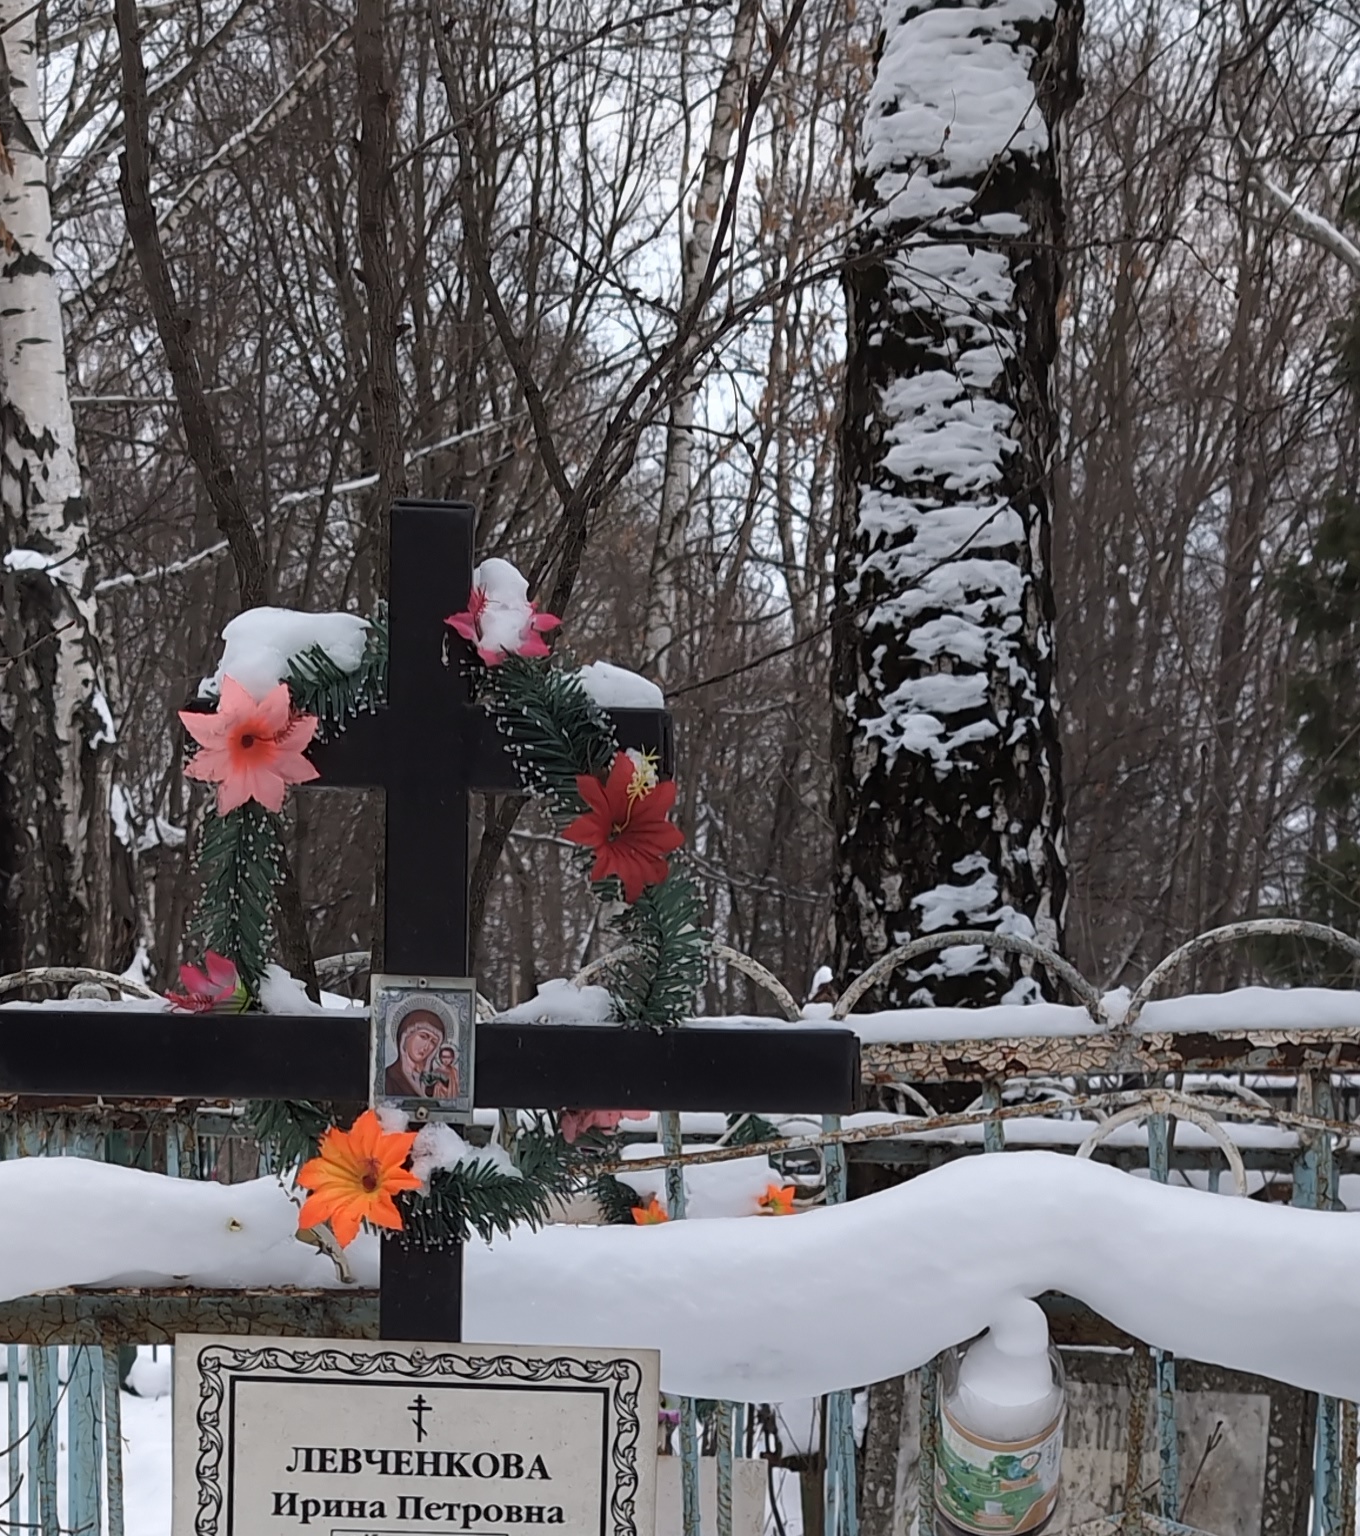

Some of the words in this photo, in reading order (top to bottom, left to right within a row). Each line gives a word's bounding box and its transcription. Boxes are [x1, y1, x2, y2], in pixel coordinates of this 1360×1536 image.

[285, 1446, 553, 1480] ЛЕВЧЕНКОВА
[271, 1491, 388, 1525] Ирина
[396, 1495, 566, 1530] Петровна
